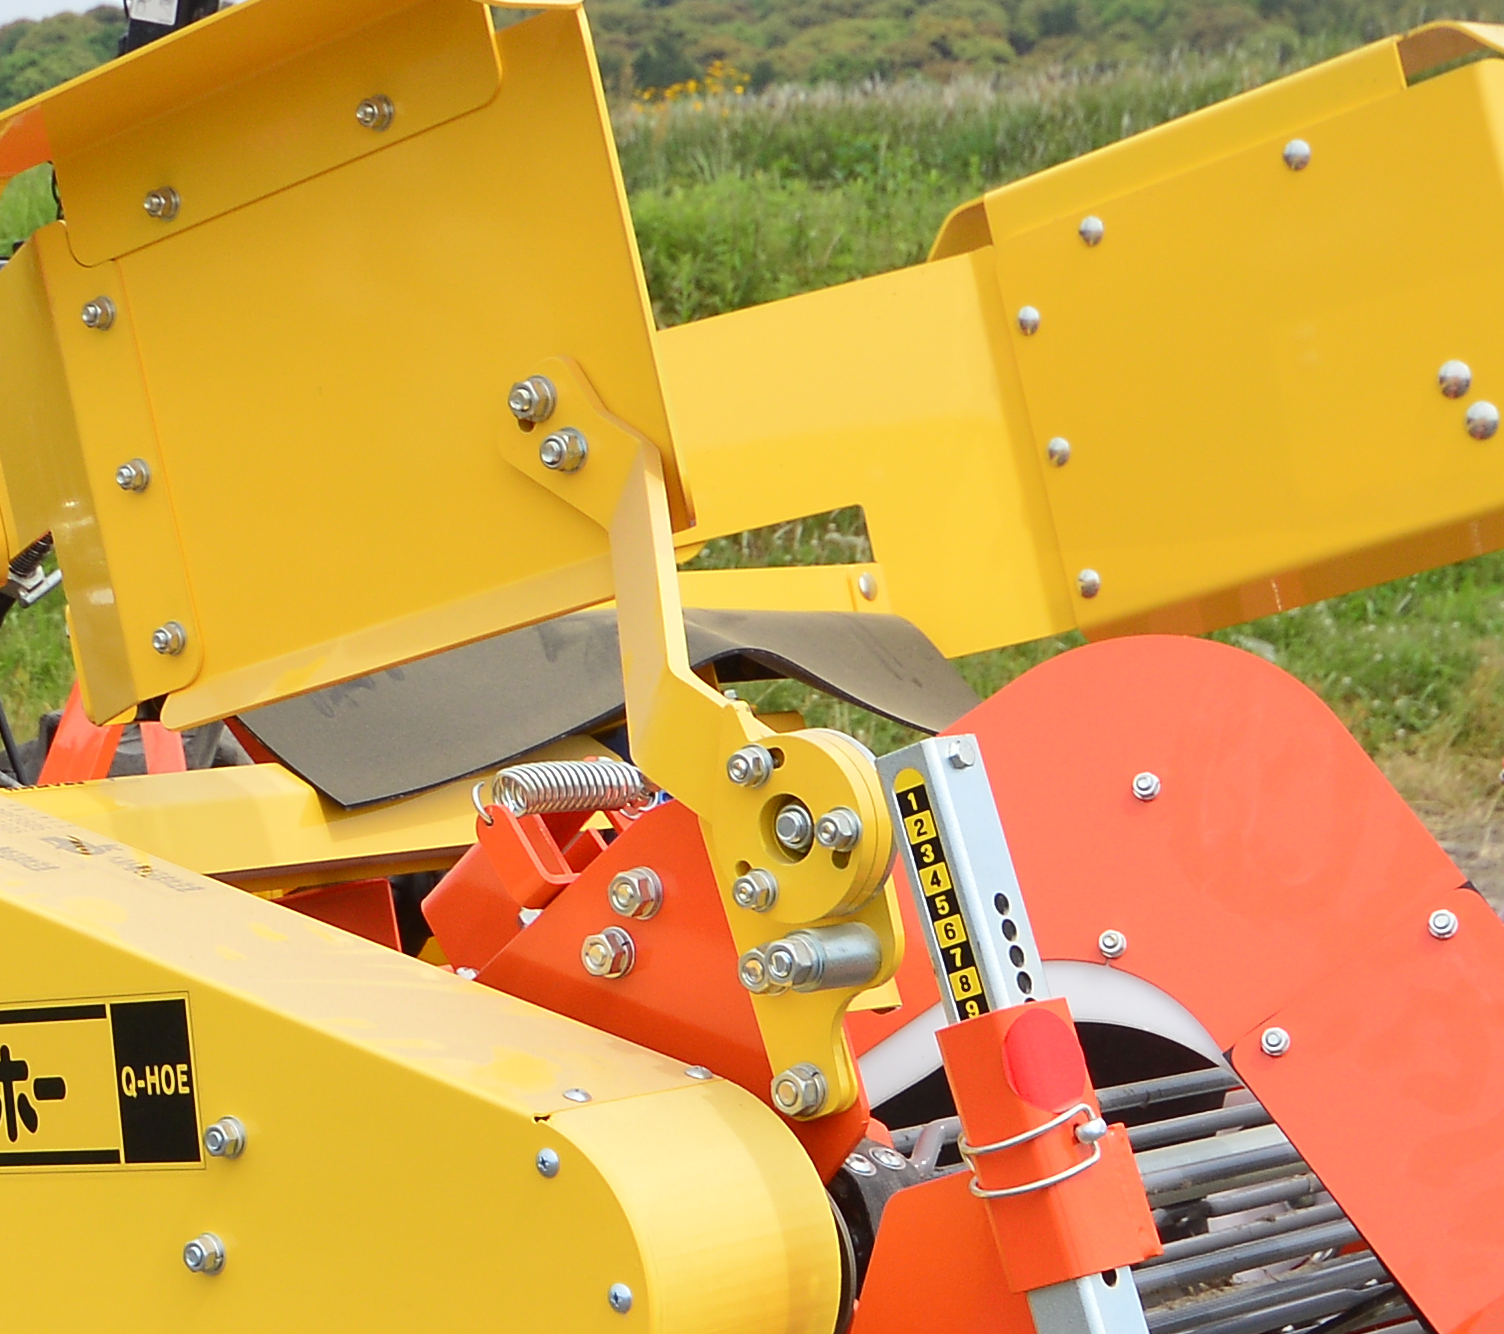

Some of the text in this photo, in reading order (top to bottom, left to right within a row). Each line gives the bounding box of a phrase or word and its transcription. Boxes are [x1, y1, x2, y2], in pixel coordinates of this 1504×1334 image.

[907, 792, 918, 811] 1
[914, 818, 928, 838] 2
[920, 843, 935, 863] 3
[930, 869, 942, 888] 4
[934, 895, 950, 915] 5
[944, 922, 957, 941] 6
[949, 947, 962, 967] 7
[959, 974, 972, 993] 8
[965, 1000, 980, 1019] 9
[121, 1063, 191, 1098] Q-HOE
